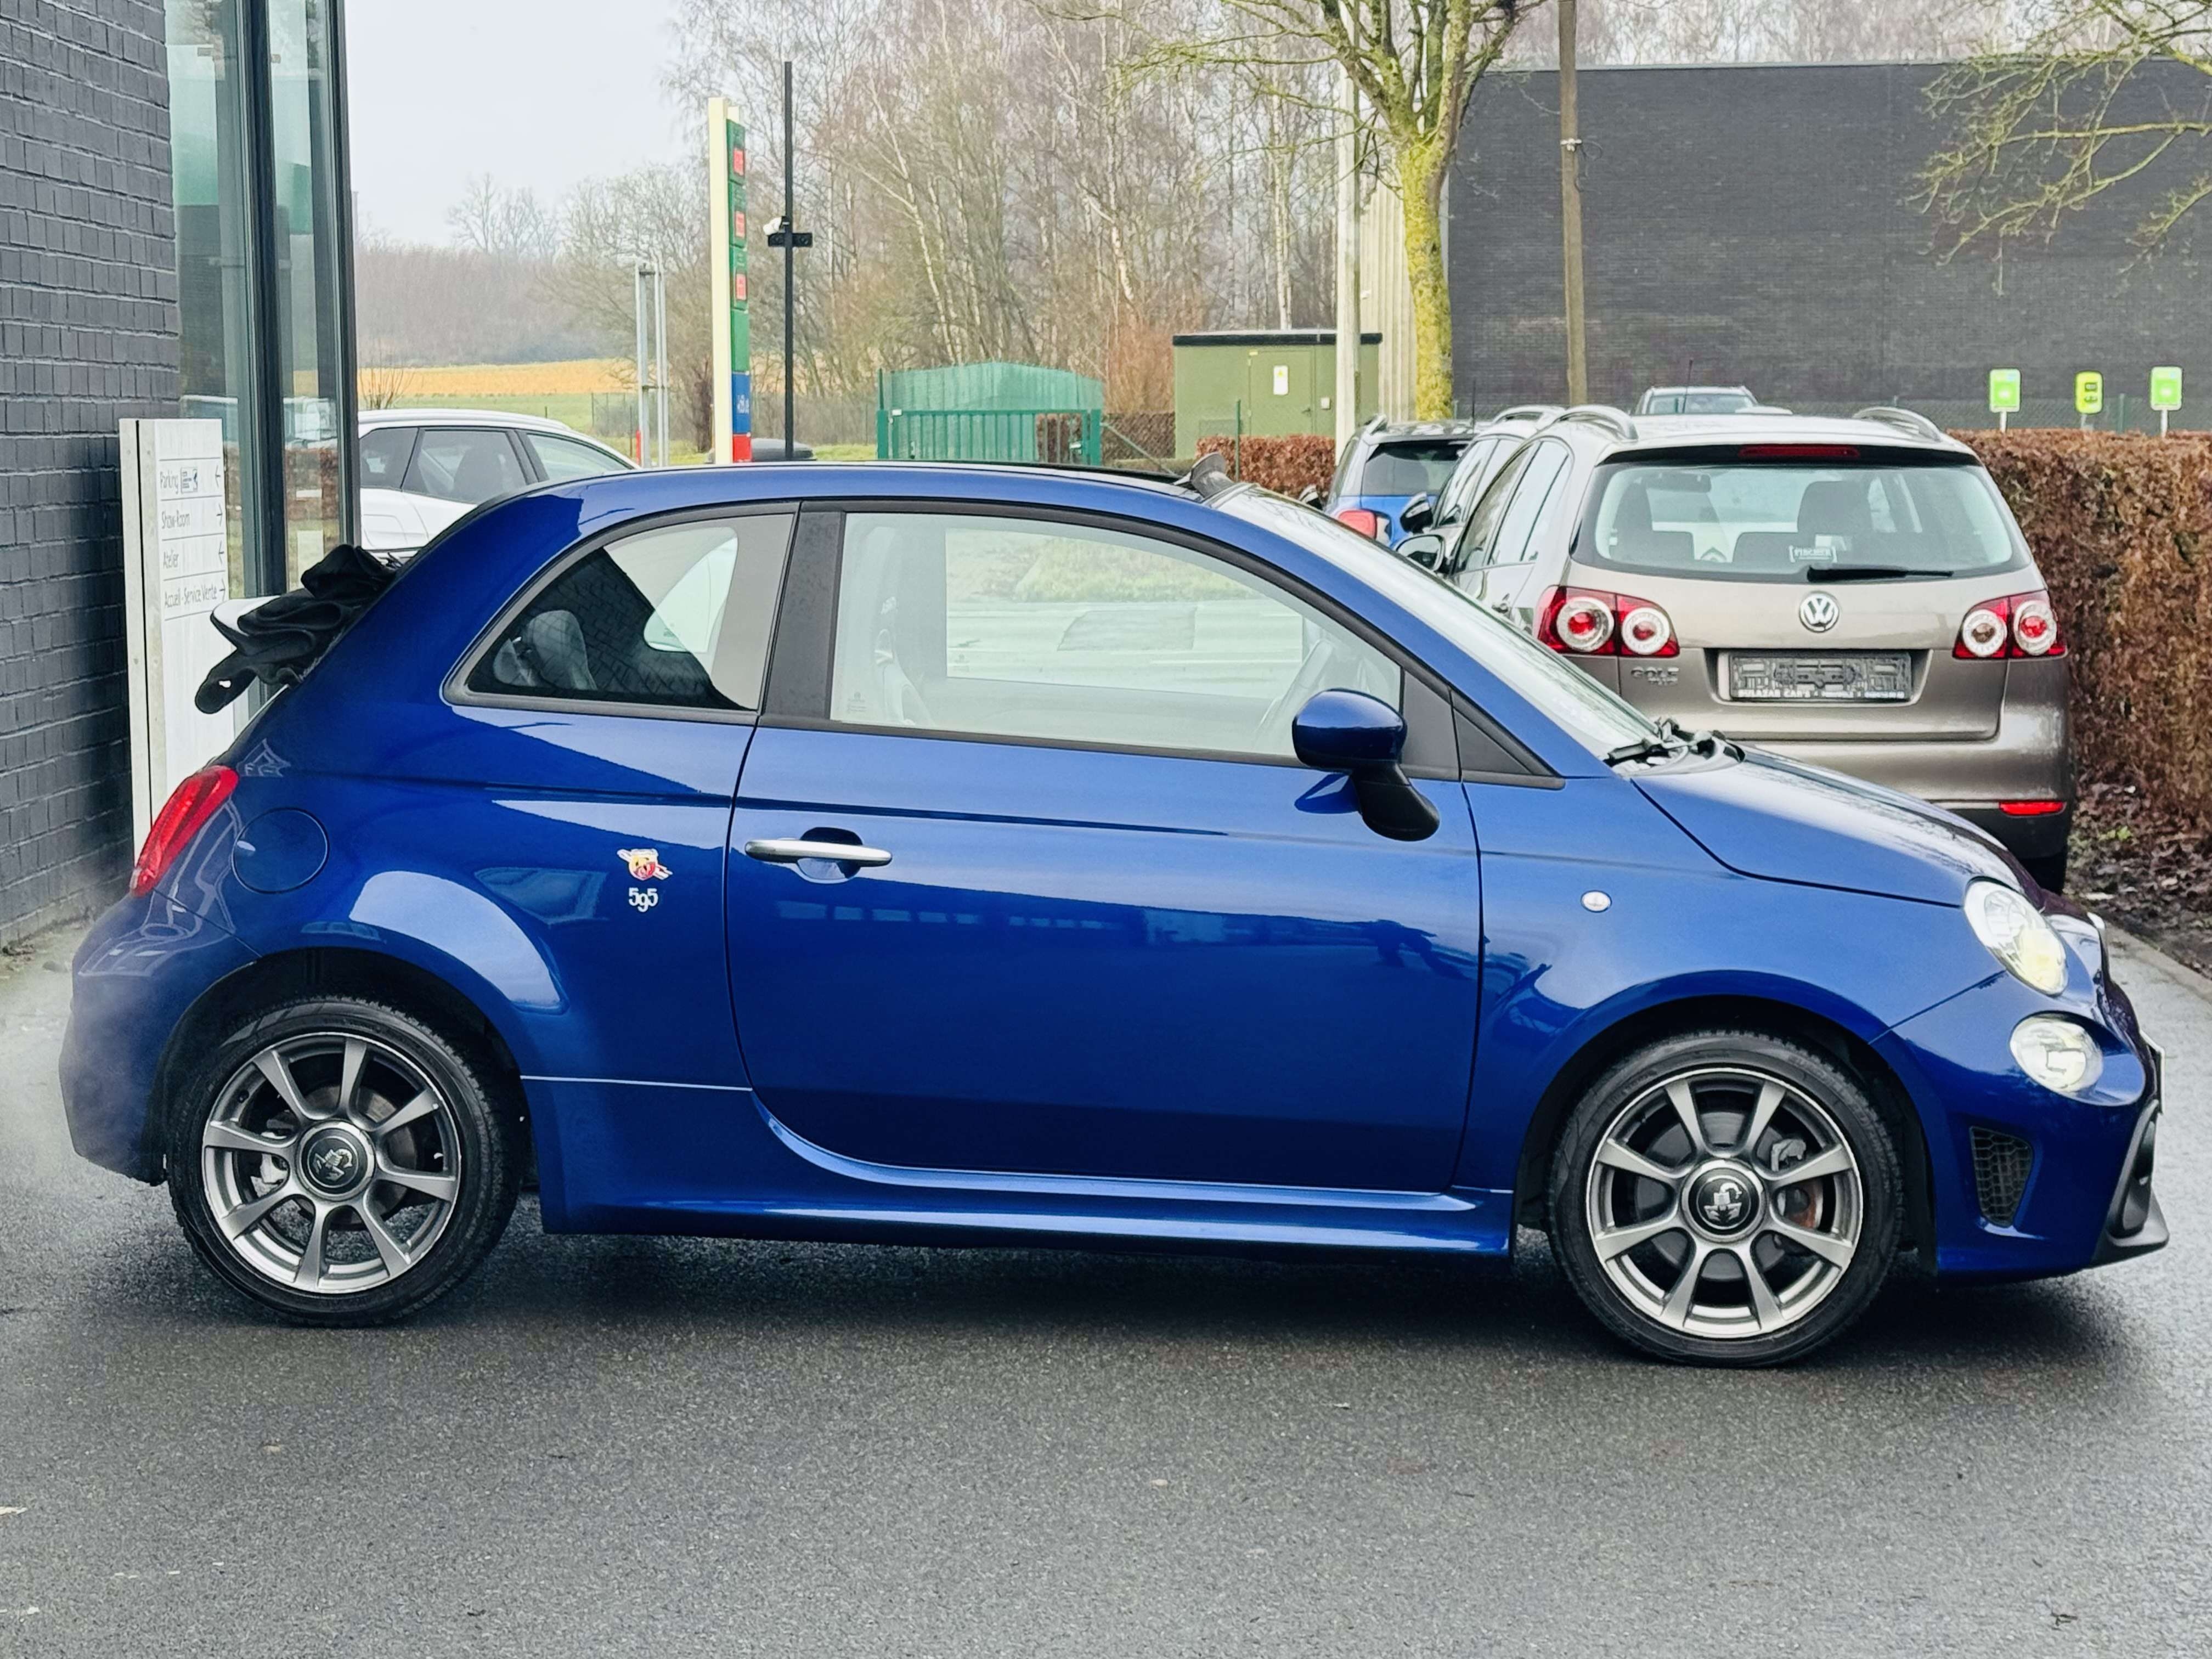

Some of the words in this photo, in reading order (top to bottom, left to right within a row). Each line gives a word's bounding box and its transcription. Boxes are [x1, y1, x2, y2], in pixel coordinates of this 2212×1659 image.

[160, 470, 179, 494] Parking
[163, 549, 179, 569] Atelier
[184, 585, 201, 605] Service
[201, 583, 217, 601] Vente
[629, 887, 658, 912] 595
